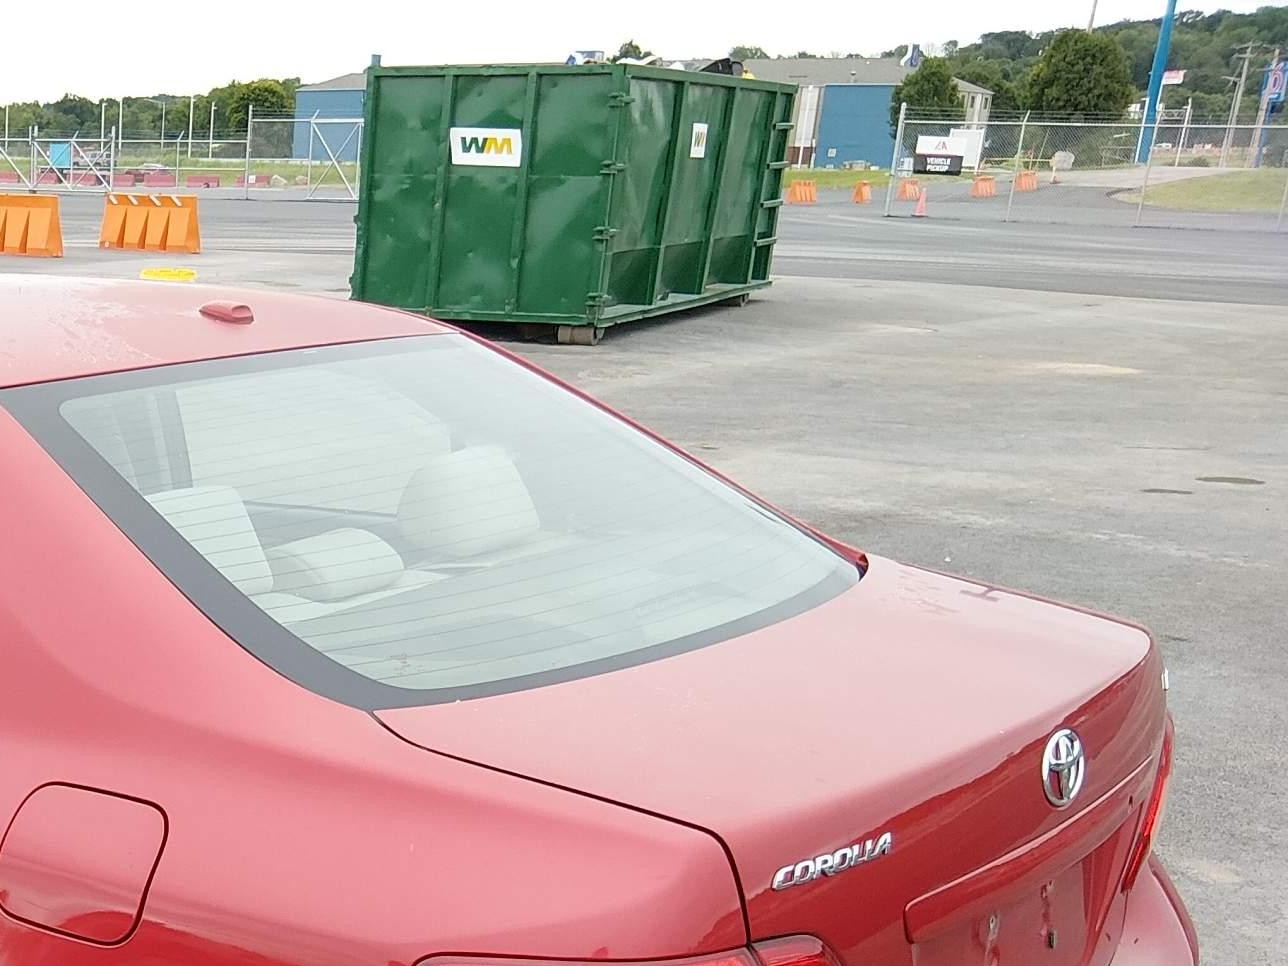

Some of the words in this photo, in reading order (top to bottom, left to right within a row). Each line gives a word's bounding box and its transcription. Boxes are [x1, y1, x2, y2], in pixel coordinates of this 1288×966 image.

[460, 136, 513, 155] WM
[926, 157, 952, 166] VEHICLE
[926, 164, 950, 173] PICKUP
[771, 831, 892, 891] COROLLA
